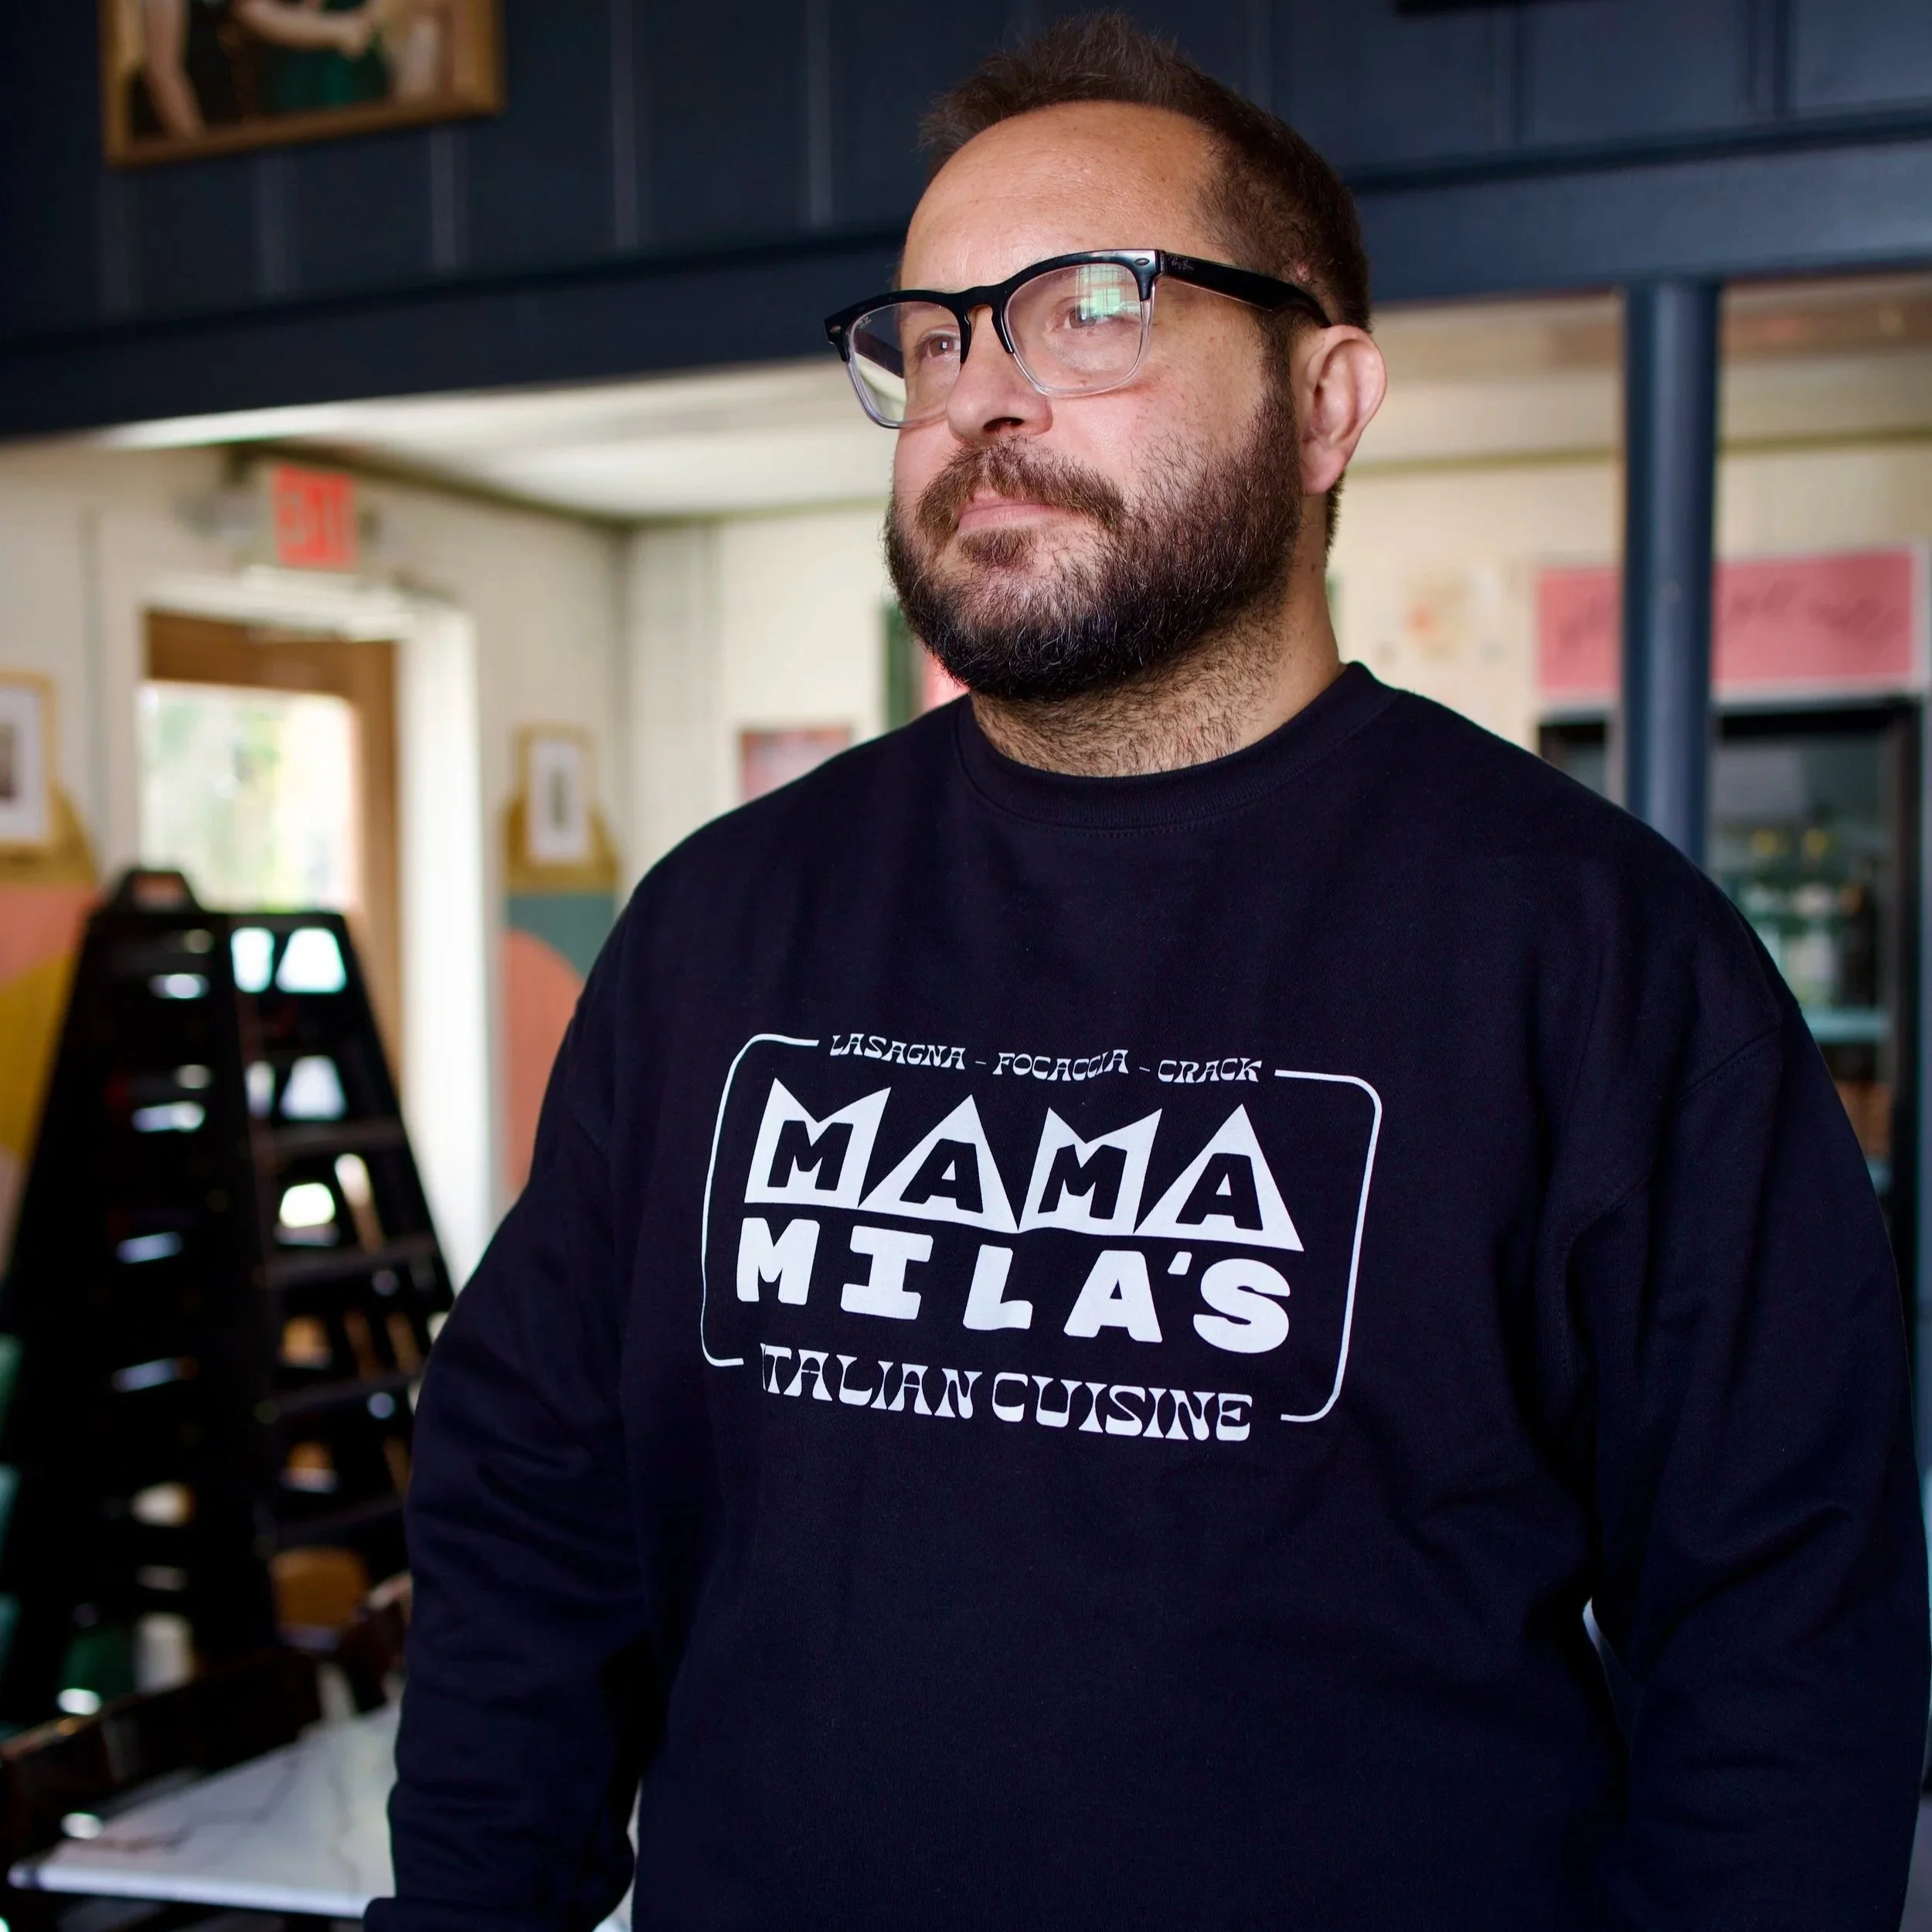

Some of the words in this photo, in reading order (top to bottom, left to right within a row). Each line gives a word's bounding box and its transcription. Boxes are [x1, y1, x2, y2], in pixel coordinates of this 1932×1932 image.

[829, 1032, 966, 1070] LASAGNA
[992, 1049, 1129, 1081] FOCACCIA
[1158, 1057, 1263, 1083] CRACK
[744, 1078, 1304, 1251] MAMA
[736, 1217, 1291, 1354] MILA'S
[760, 1342, 983, 1420] ITALIAN
[992, 1372, 1253, 1441] CUISINE
